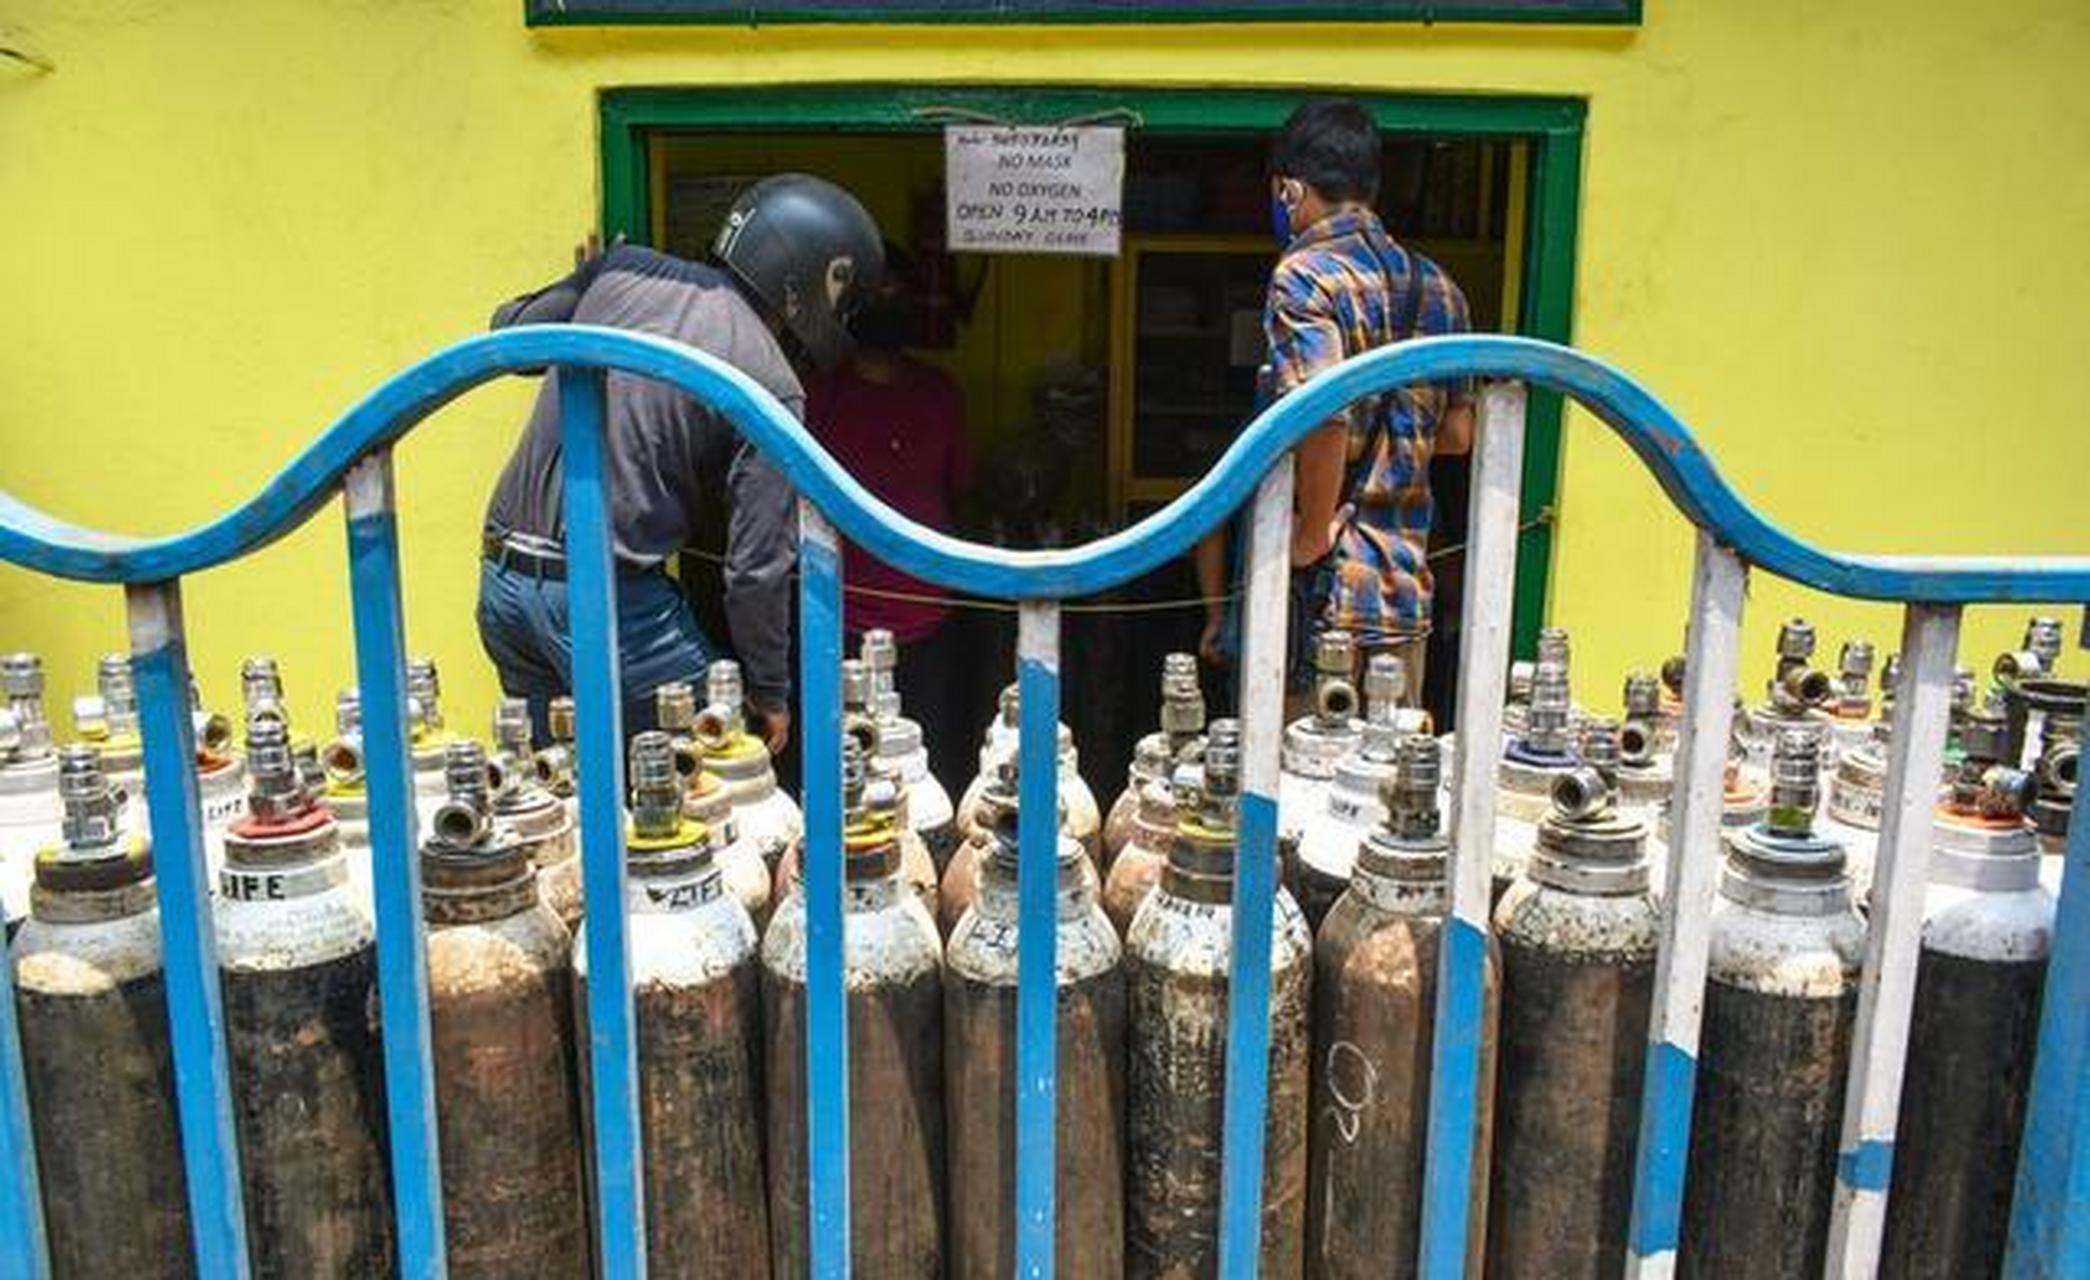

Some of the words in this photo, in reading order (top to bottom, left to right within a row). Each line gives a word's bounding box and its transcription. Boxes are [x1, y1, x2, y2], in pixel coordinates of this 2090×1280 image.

[1000, 153, 1024, 170] NO
[1028, 154, 1072, 169] MASK
[989, 182, 1013, 197] NO
[1017, 181, 1081, 198] OXYGEN
[956, 204, 1003, 220] OPEN
